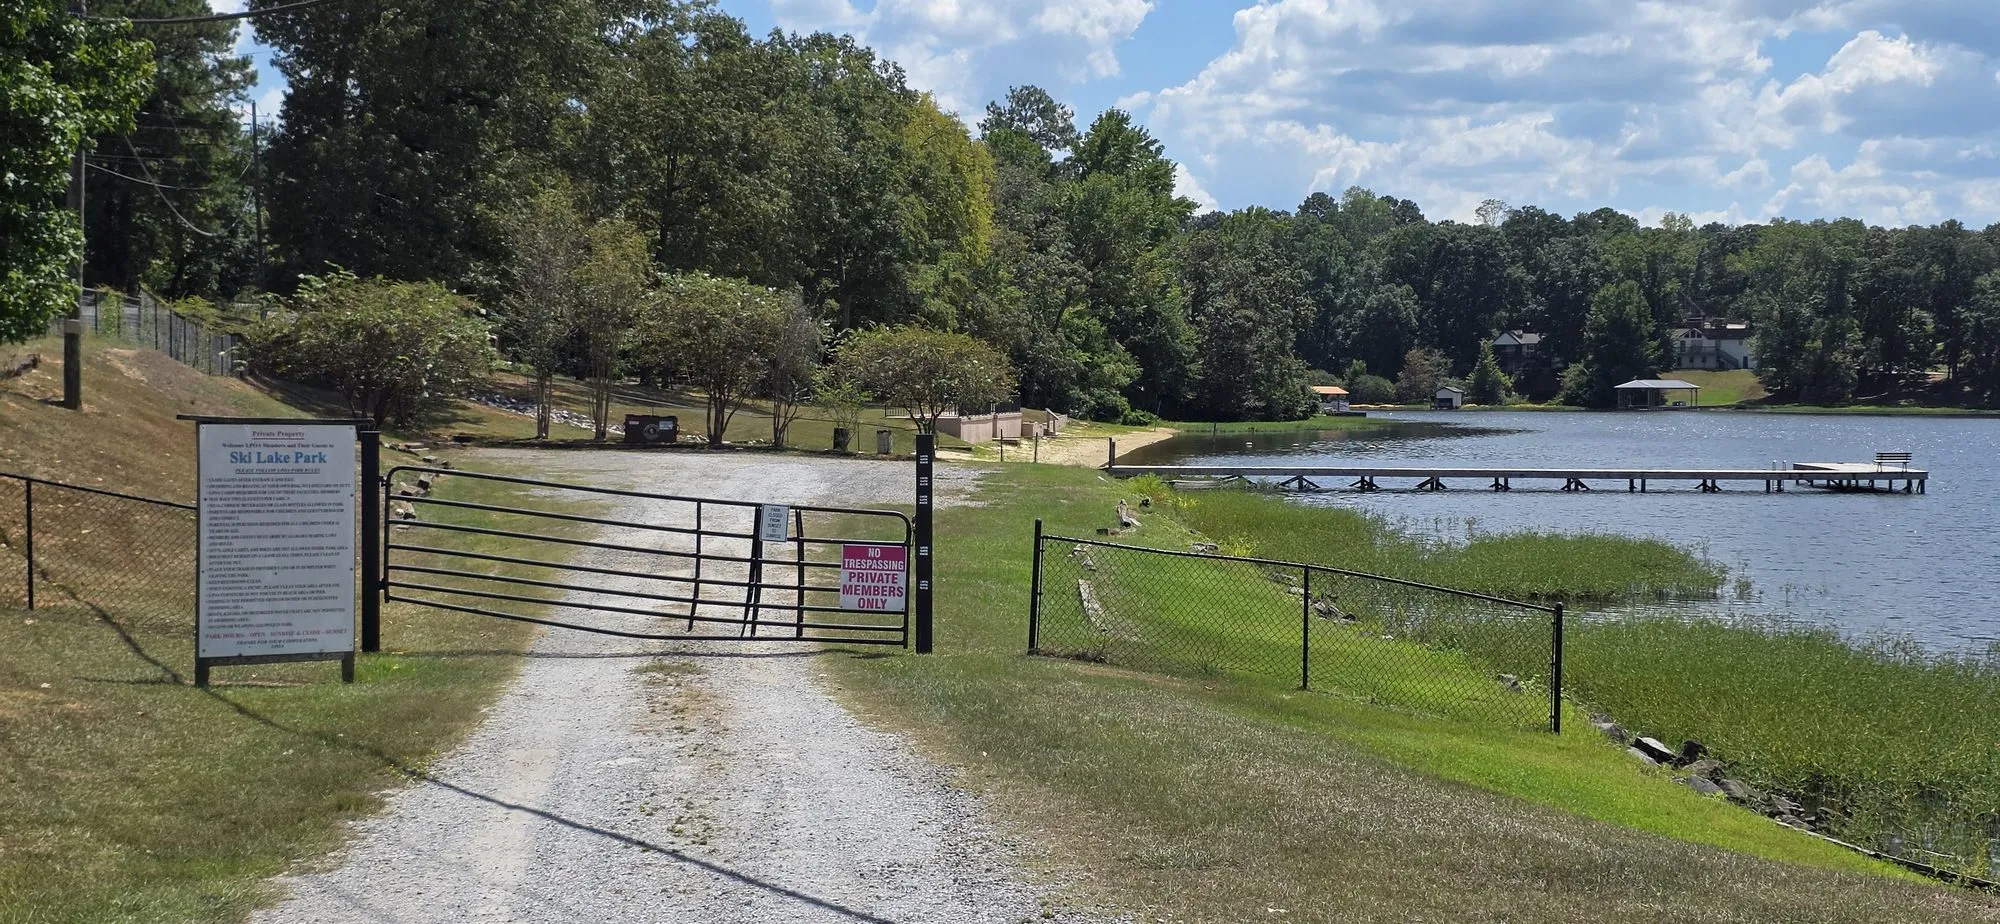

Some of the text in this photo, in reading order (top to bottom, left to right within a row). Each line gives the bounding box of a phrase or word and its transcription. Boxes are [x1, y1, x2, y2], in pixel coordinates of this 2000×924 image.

[230, 451, 327, 463] Ski Lake Park
[868, 548, 881, 557] NO
[844, 558, 904, 570] TRESPASSING
[848, 572, 898, 584] PRIVATE
[842, 584, 903, 597] MEMBERS
[858, 598, 888, 610] ONLY
